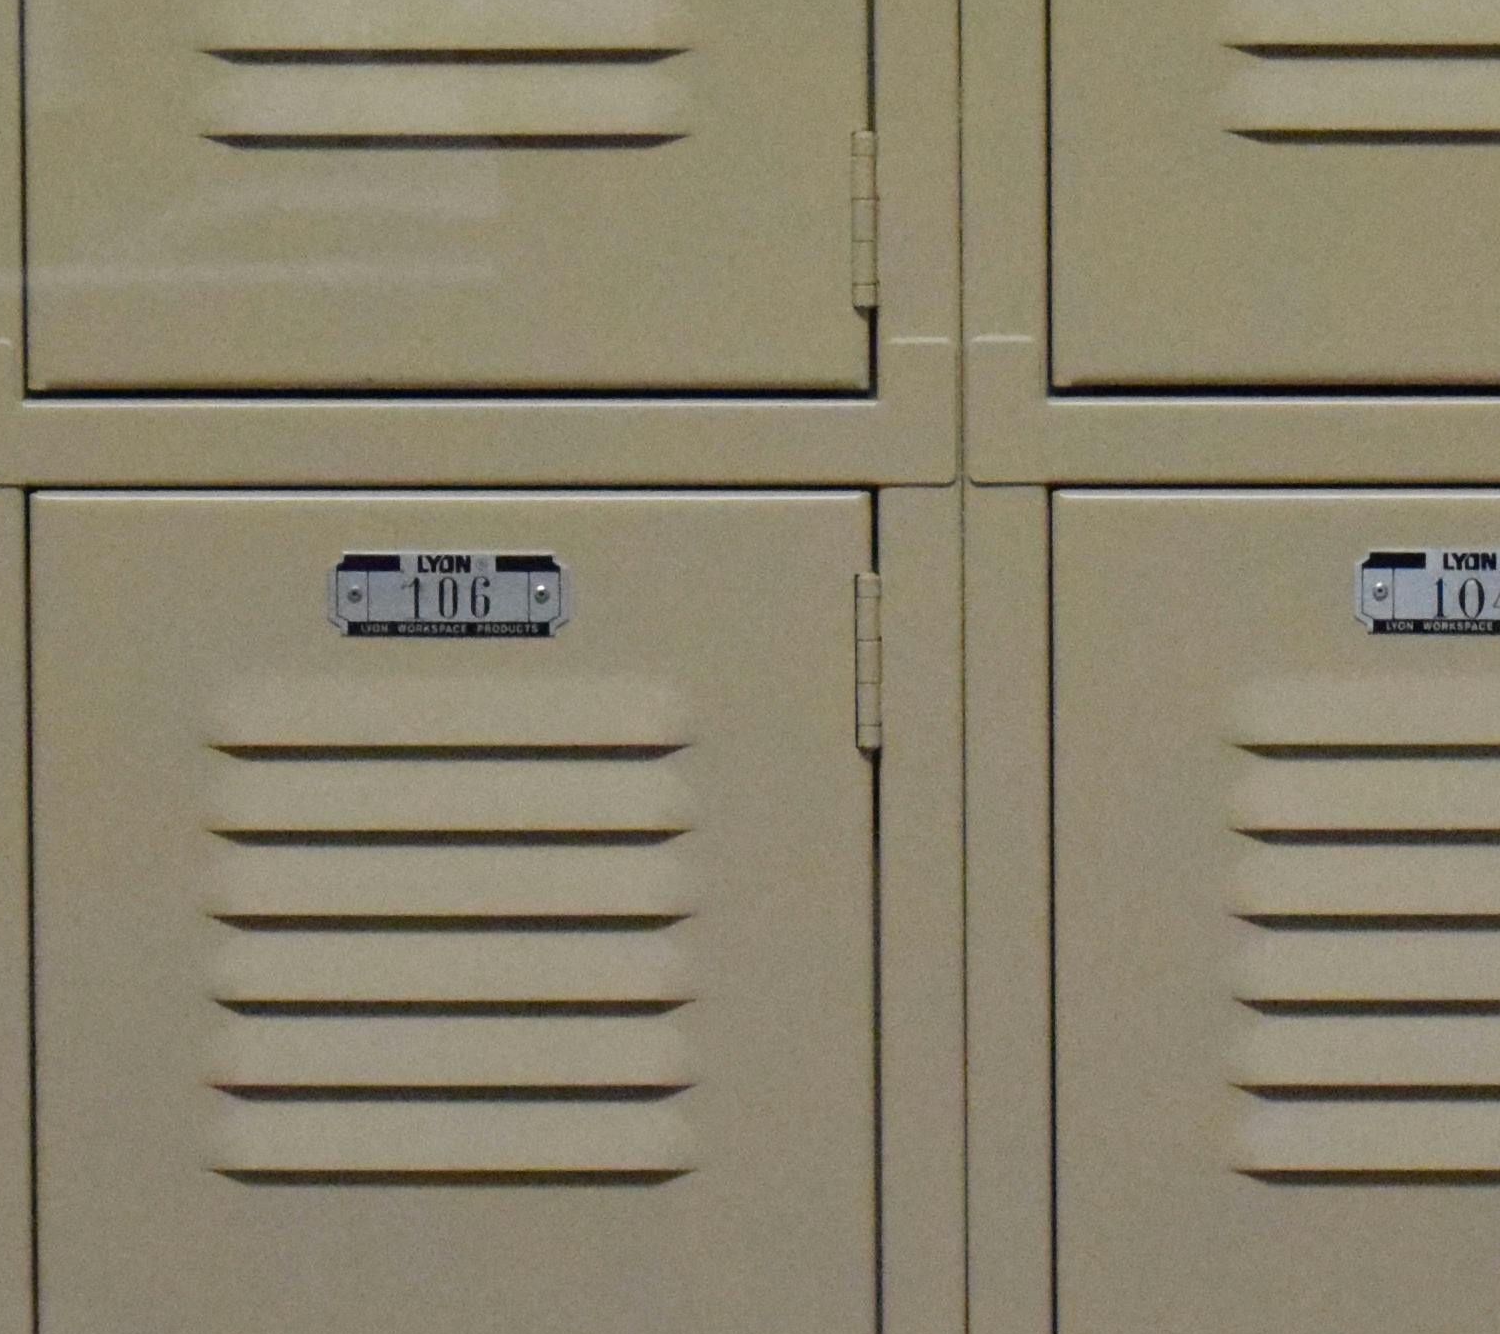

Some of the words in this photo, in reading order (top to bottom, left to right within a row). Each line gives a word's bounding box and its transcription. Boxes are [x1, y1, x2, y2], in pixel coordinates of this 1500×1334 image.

[417, 555, 471, 573] LYON
[1443, 552, 1497, 570] LYON
[402, 575, 491, 619] 106
[361, 624, 388, 634] LYON
[477, 624, 539, 634] PRODUCTS
[1386, 620, 1414, 631] LYON
